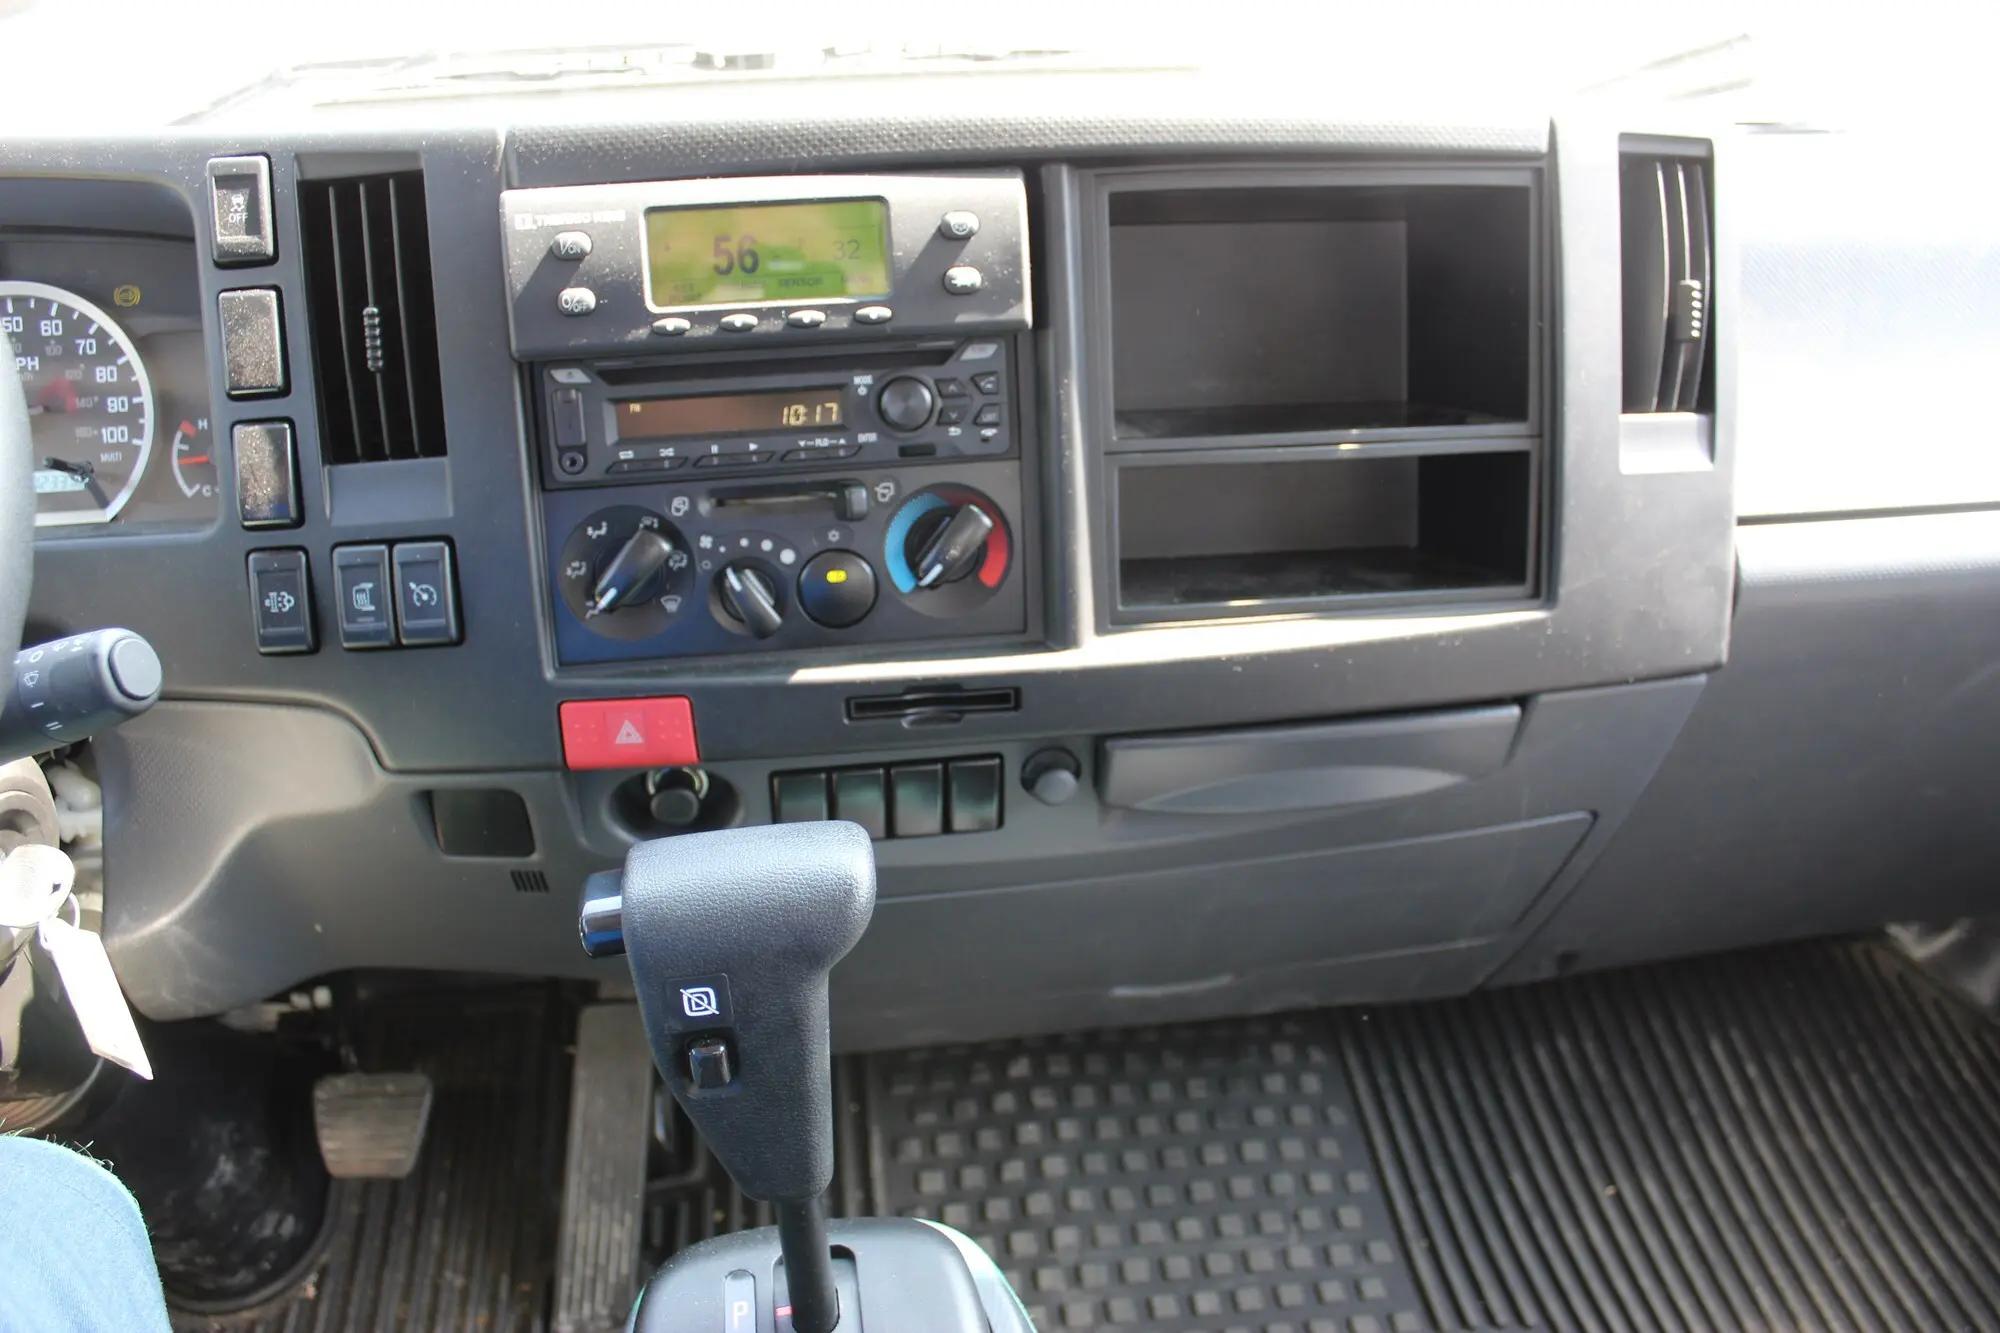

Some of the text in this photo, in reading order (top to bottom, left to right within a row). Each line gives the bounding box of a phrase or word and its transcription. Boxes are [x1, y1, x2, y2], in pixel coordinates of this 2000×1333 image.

[228, 212, 249, 224] OFF
[712, 233, 760, 276] 56
[832, 238, 861, 260] 32
[2, 316, 24, 333] 50
[40, 319, 63, 336] 60
[75, 338, 97, 355] 70
[15, 356, 40, 371] PH
[95, 366, 118, 383] 80
[853, 375, 873, 386] MODE
[782, 402, 839, 426] 10:17
[198, 418, 208, 431] H
[101, 426, 129, 444] 100
[202, 485, 212, 498] C
[733, 1301, 747, 1329] P
